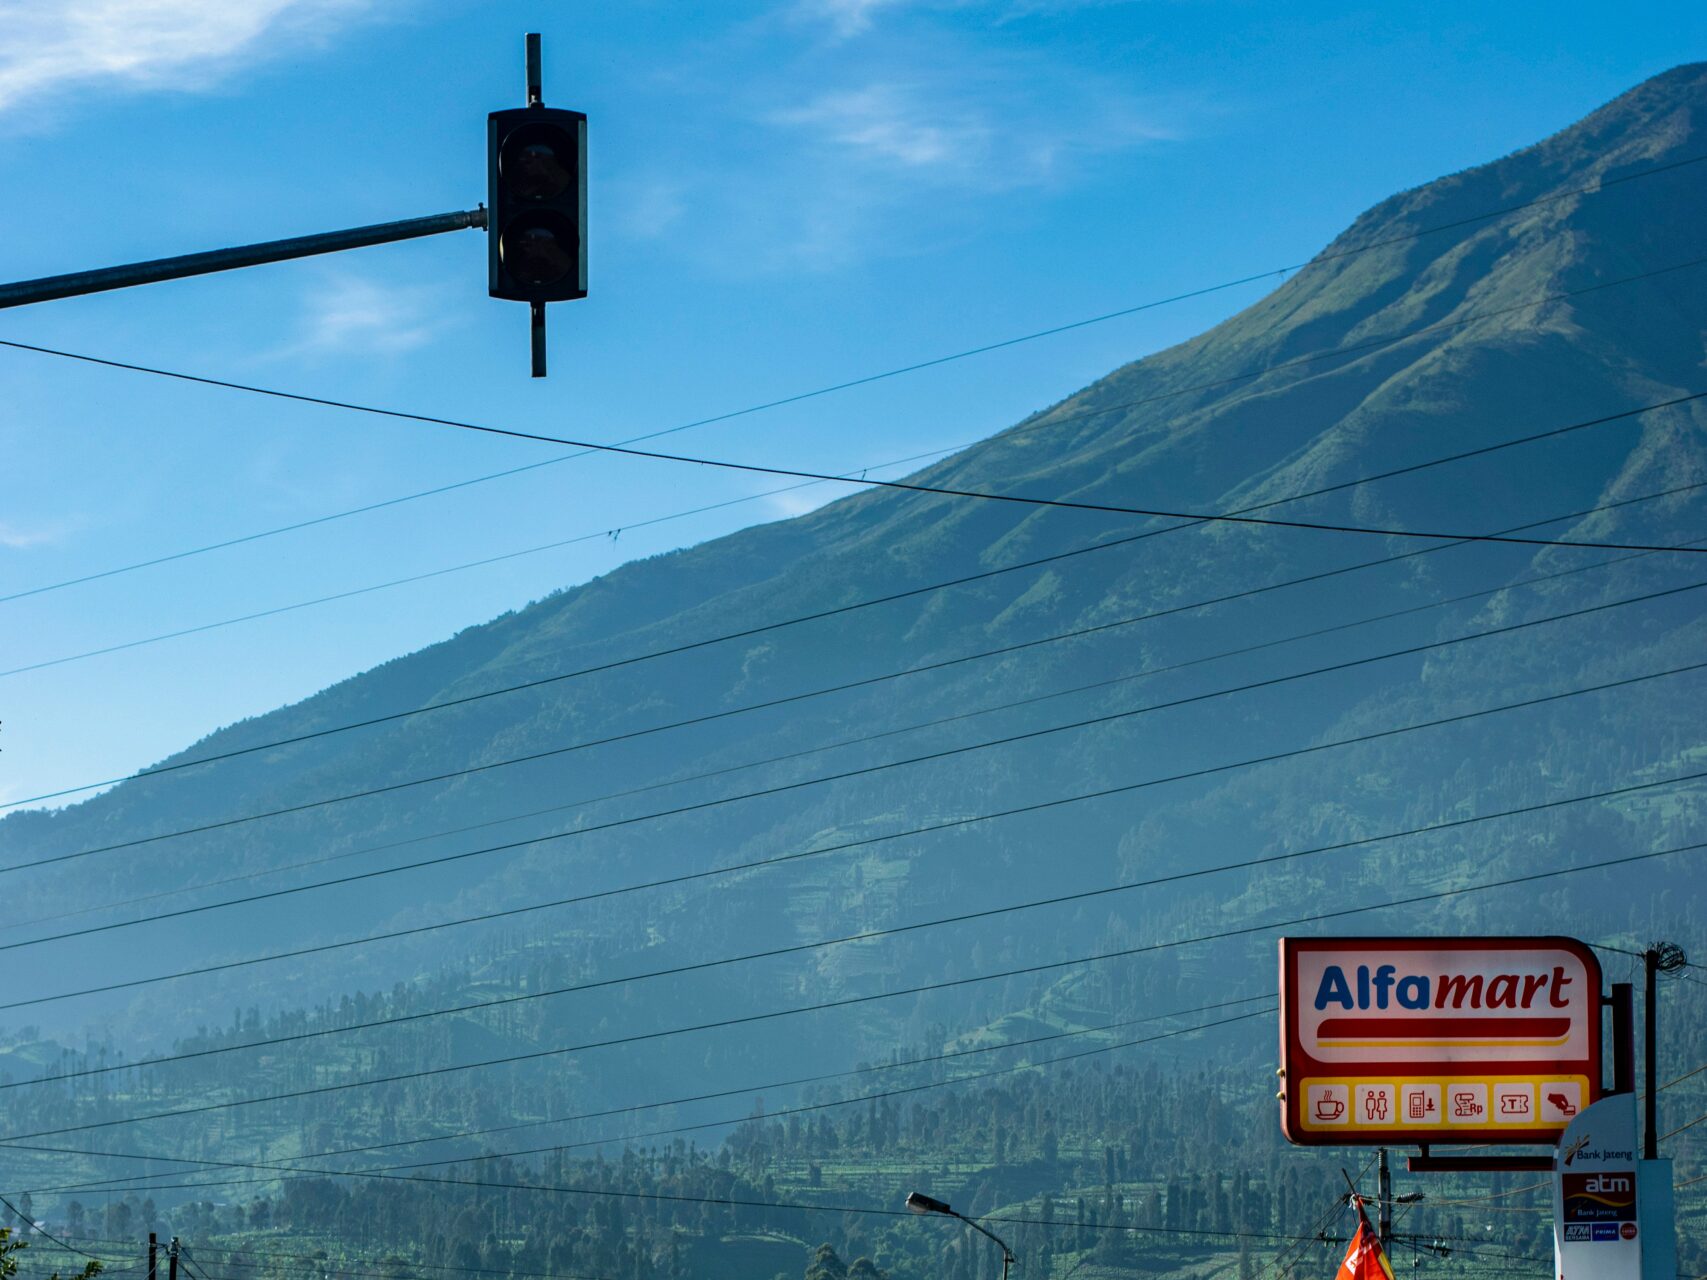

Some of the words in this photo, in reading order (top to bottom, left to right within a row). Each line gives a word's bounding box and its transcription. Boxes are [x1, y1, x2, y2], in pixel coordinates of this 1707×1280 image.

[1314, 965, 1572, 1010] Alfamart
[1577, 1150, 1600, 1160] Bank
[1603, 1149, 1633, 1162] Jateng
[1585, 1174, 1630, 1193] atm
